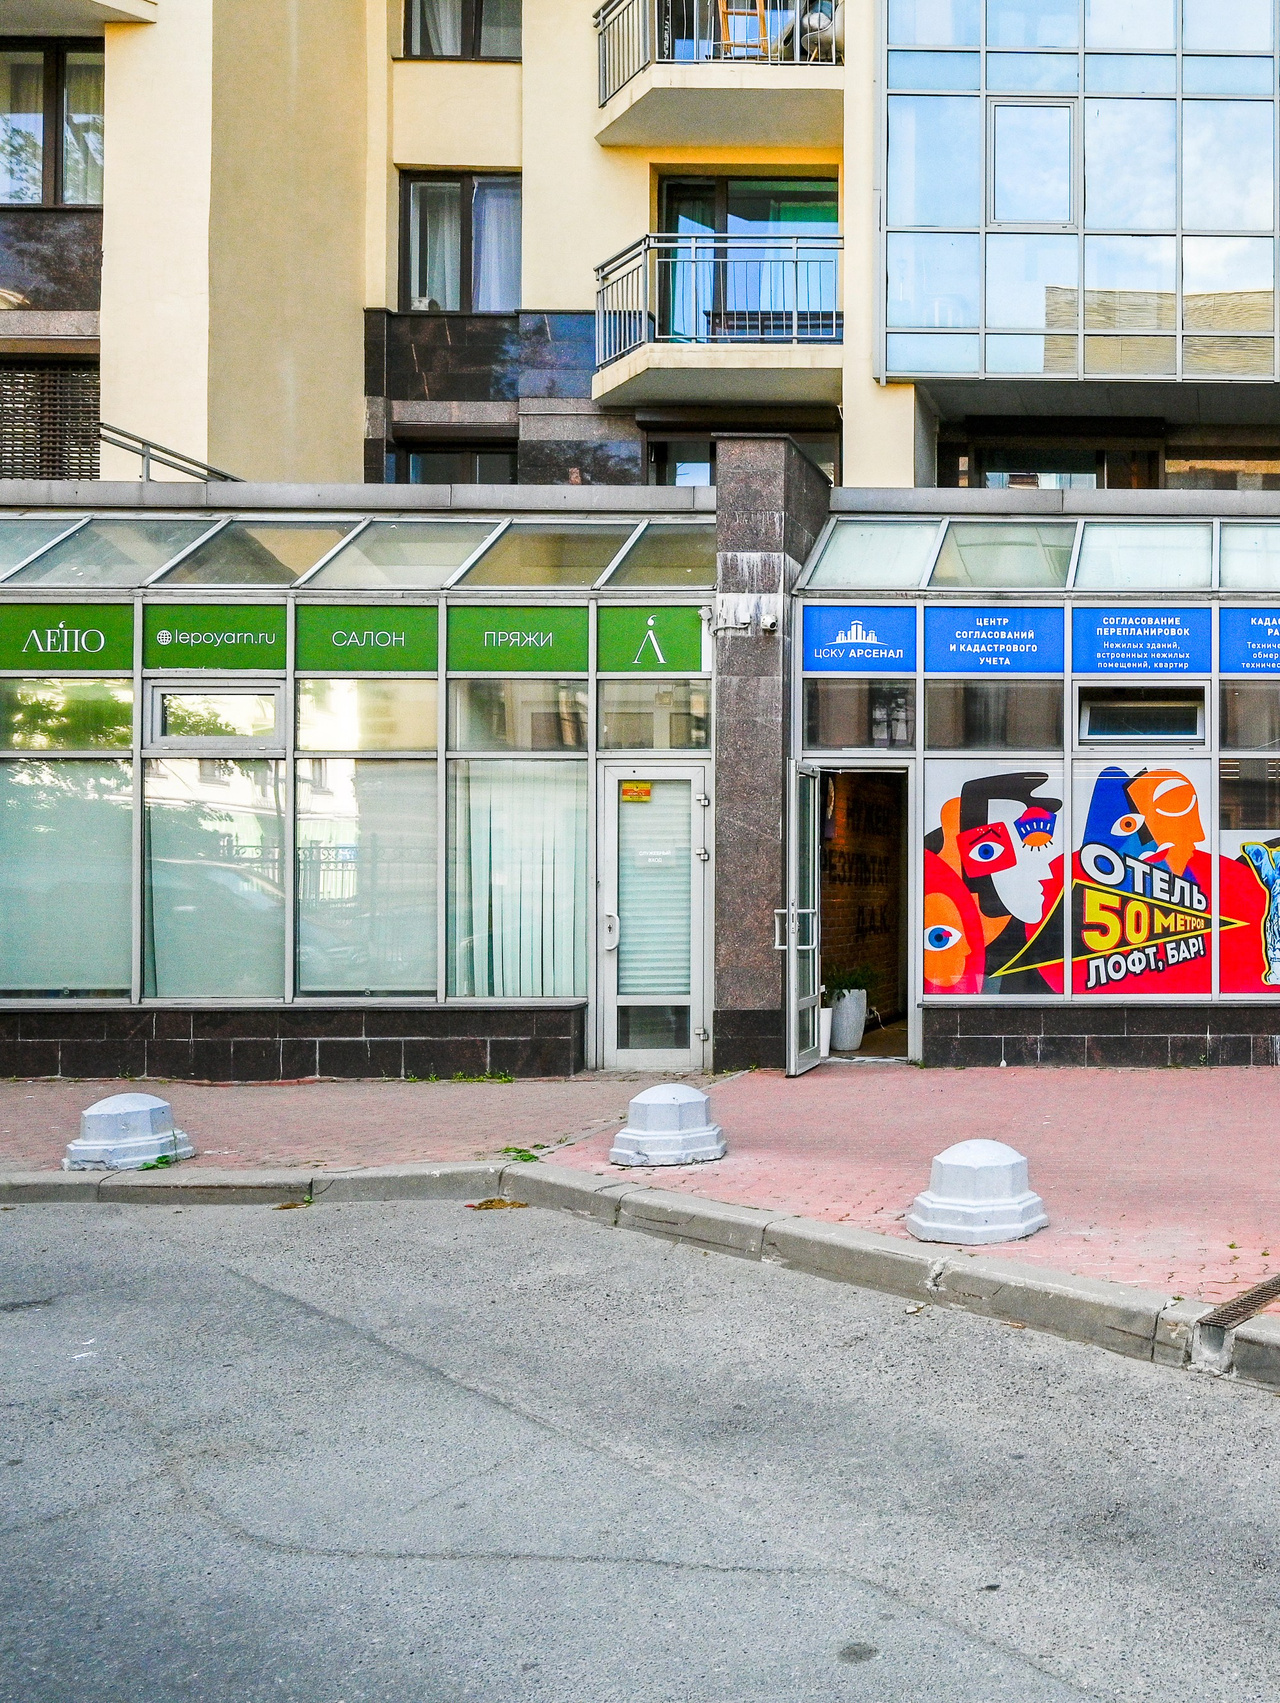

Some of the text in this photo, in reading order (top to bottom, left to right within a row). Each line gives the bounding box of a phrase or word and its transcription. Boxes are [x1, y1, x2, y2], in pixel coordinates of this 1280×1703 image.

[975, 618, 1010, 627] ЦЕНТР
[1102, 617, 1181, 626] СОГЛАСОВАНИЕ
[955, 630, 1035, 640] СОГЛАСОВАНИЙ
[1096, 628, 1190, 636] ПЕРЕПЛАНИРОВОК
[176, 629, 275, 646] lepoyarn.ru
[333, 631, 404, 646] САЛОН
[485, 632, 552, 646] ПРЯЖИ
[949, 644, 1038, 654] И КАДАСТРОВОГО
[1146, 642, 1181, 650] зданий,
[814, 649, 904, 659] ЦСКУ АРСЕНАЛ
[978, 657, 1011, 666] УЧЕТА
[1097, 661, 1189, 670] помещений, квартир
[1080, 843, 1207, 911] ОТЕЛЬ
[1083, 888, 1205, 951] 50 МЕТРОВ
[1087, 935, 1205, 989] ЛОФТ, БАР!
